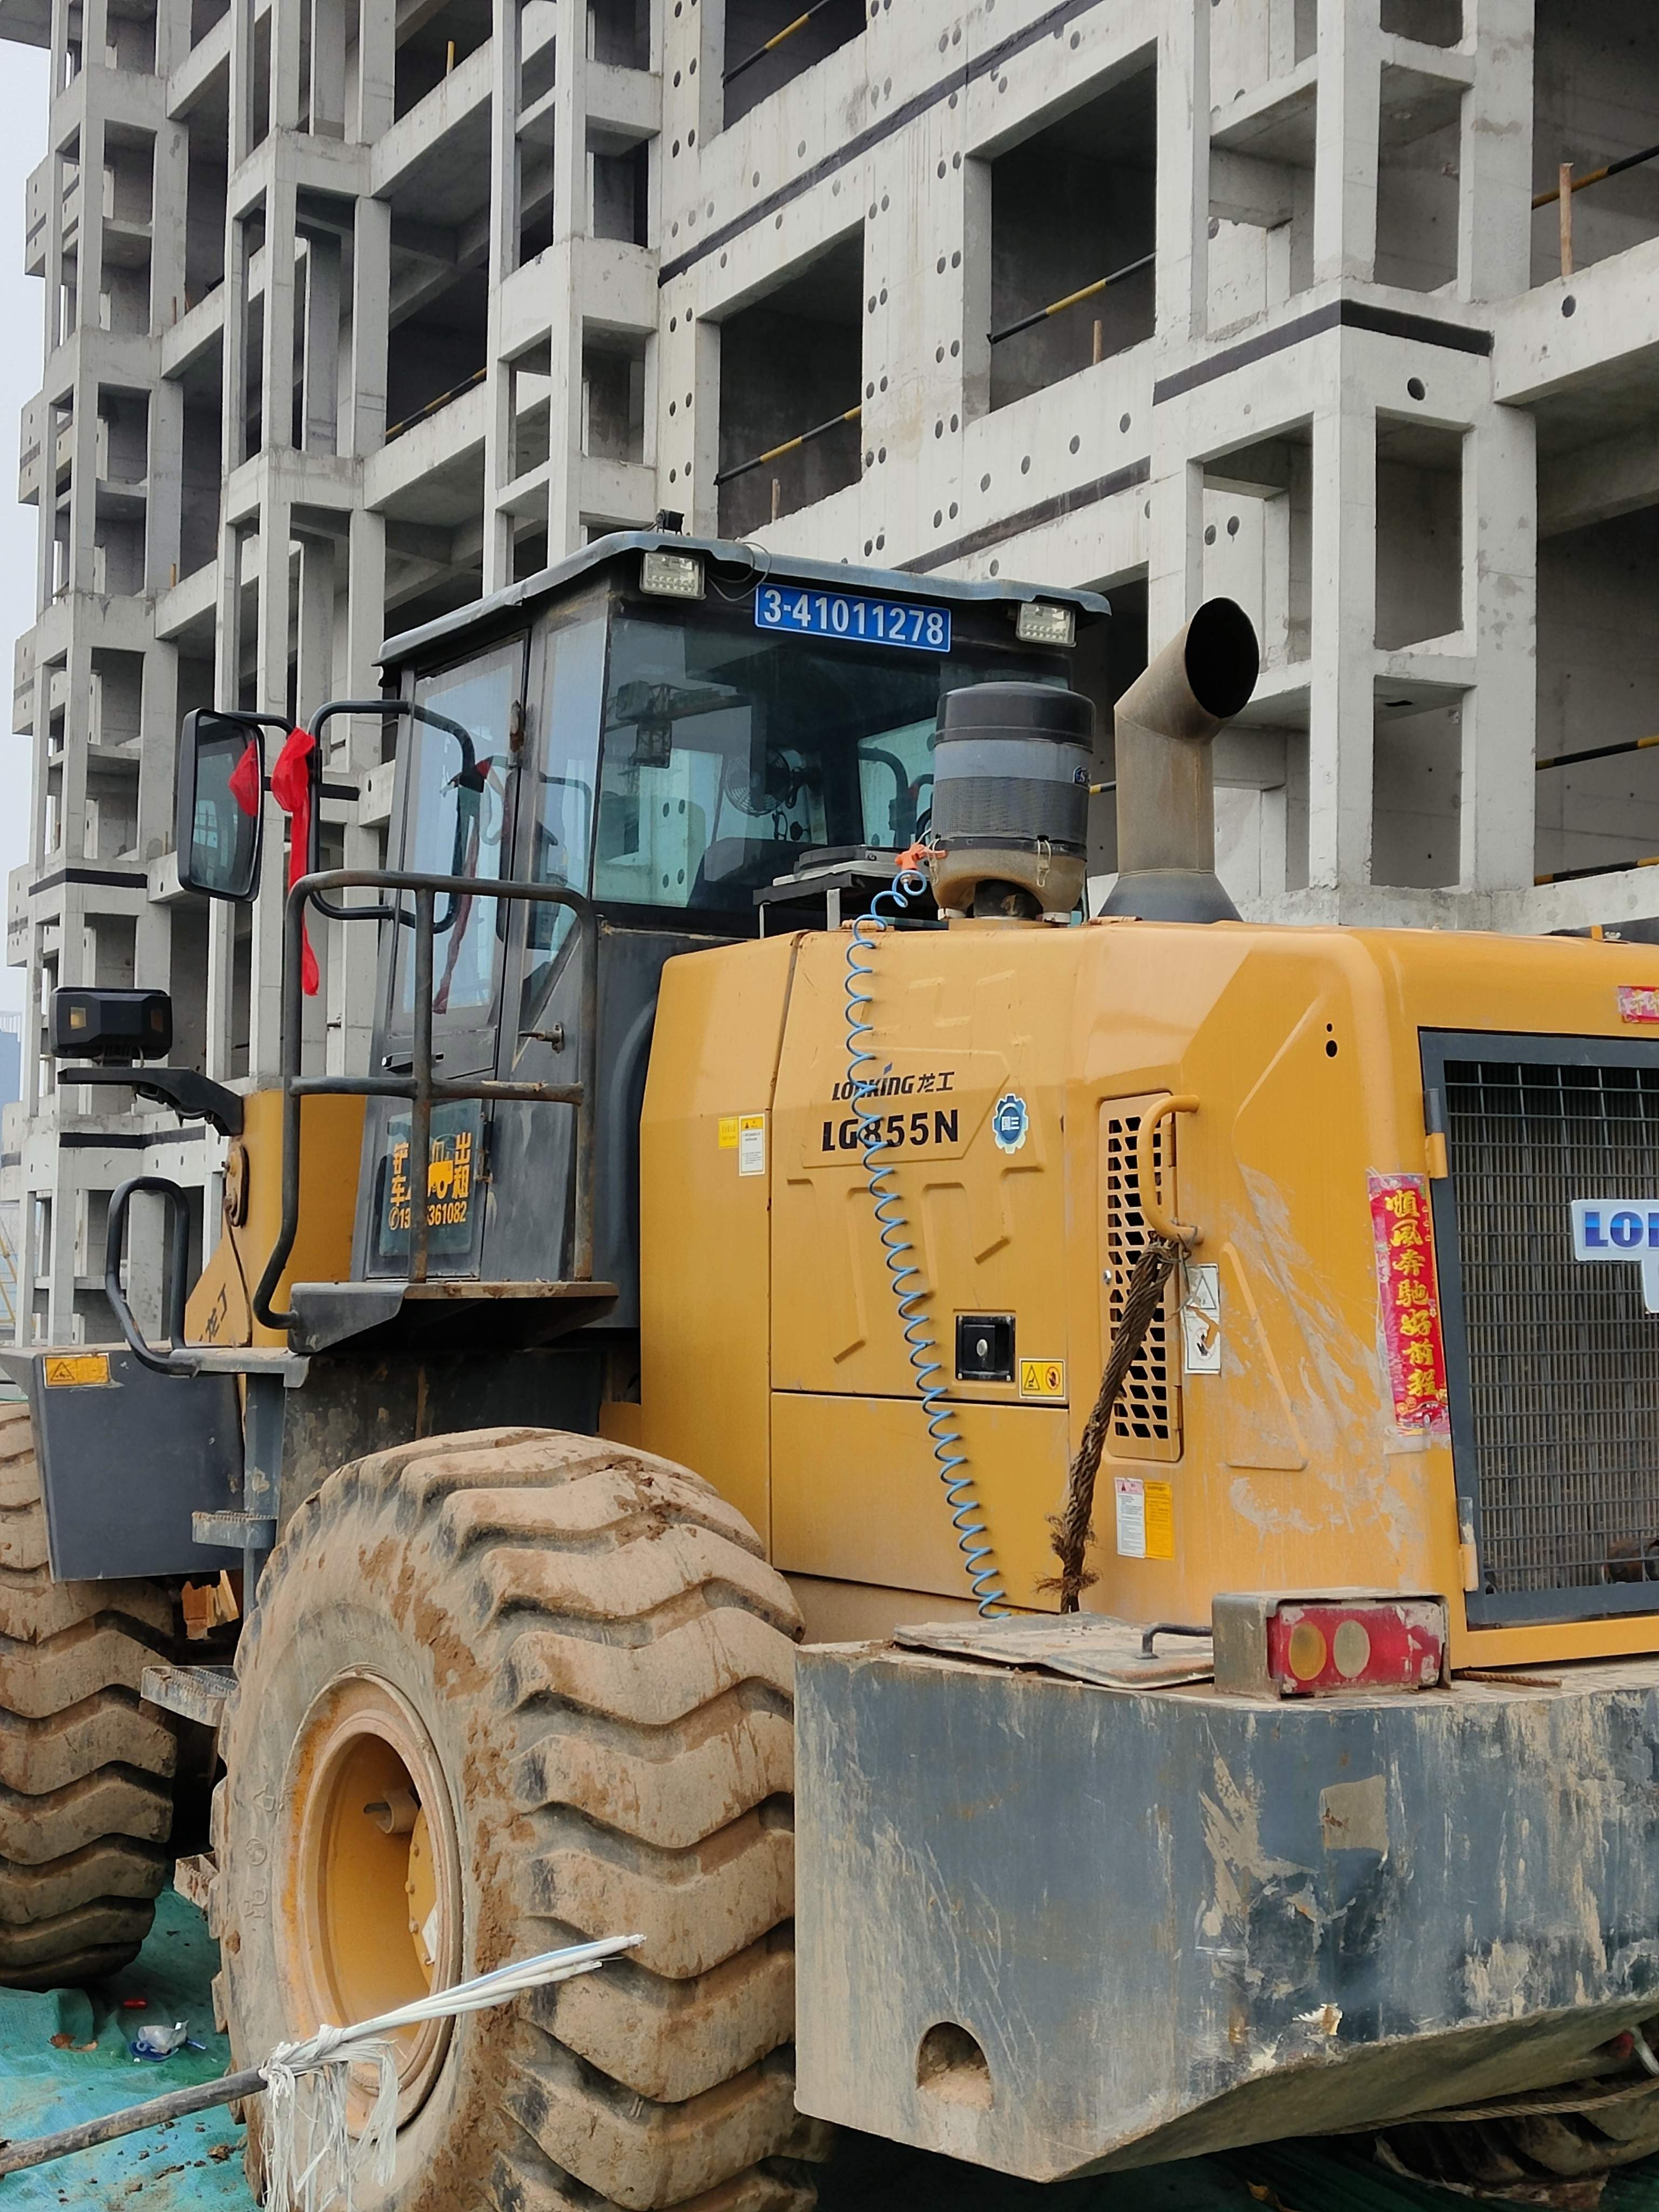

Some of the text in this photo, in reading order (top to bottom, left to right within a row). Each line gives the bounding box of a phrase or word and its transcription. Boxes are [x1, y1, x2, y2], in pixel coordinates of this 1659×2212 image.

[763, 589, 944, 646] 3-41011278
[916, 1071, 955, 1093] 龙工
[822, 1109, 959, 1151] LG855N
[452, 1132, 471, 1199] 出租
[400, 1201, 467, 1229] 13361082
